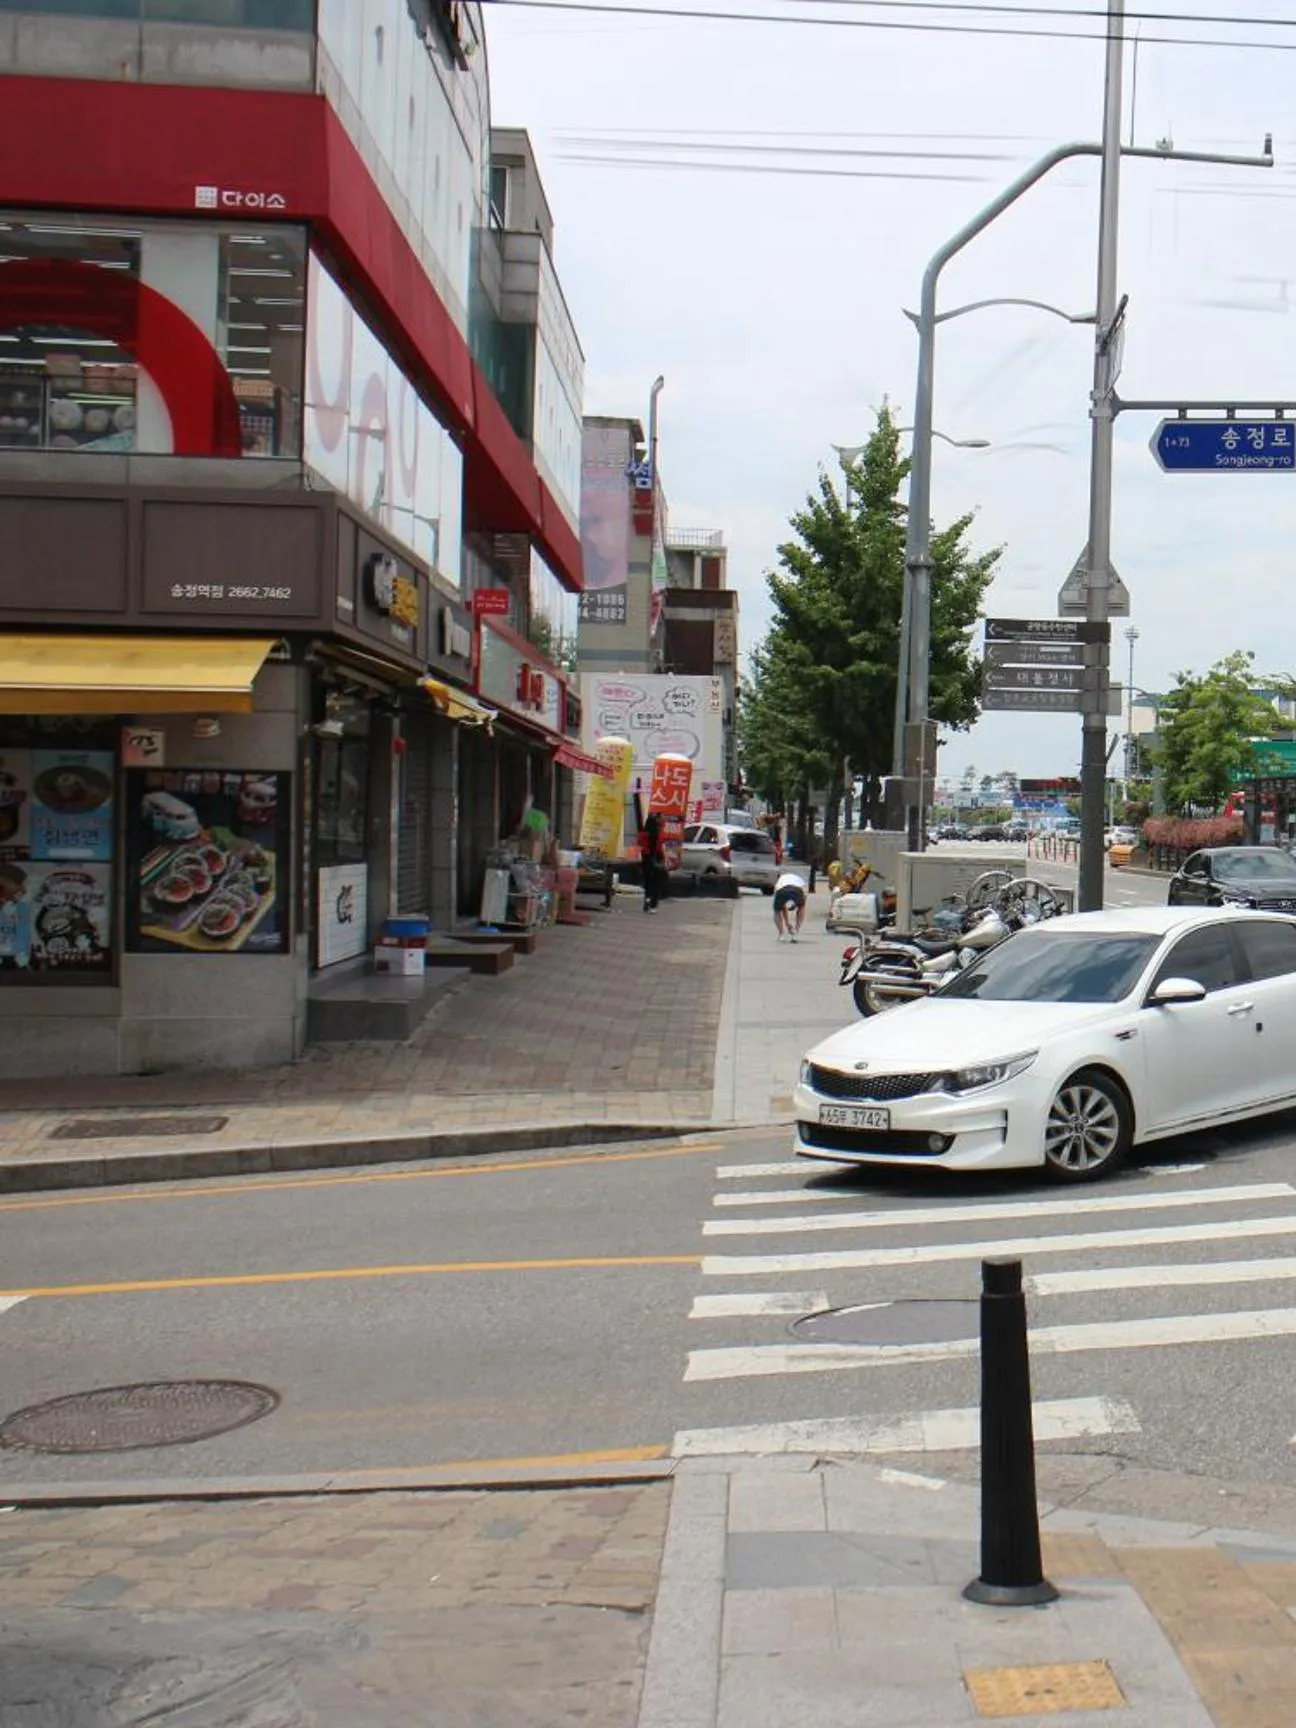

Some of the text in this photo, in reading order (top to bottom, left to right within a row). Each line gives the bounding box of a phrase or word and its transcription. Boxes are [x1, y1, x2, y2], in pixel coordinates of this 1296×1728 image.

[222, 191, 286, 208] 다이소
[1221, 426, 1292, 450] 송정로
[1215, 453, 1292, 468] Songjeong-ro
[171, 584, 223, 598] 송정역점
[654, 767, 689, 786] 나도
[650, 789, 686, 812] 스시
